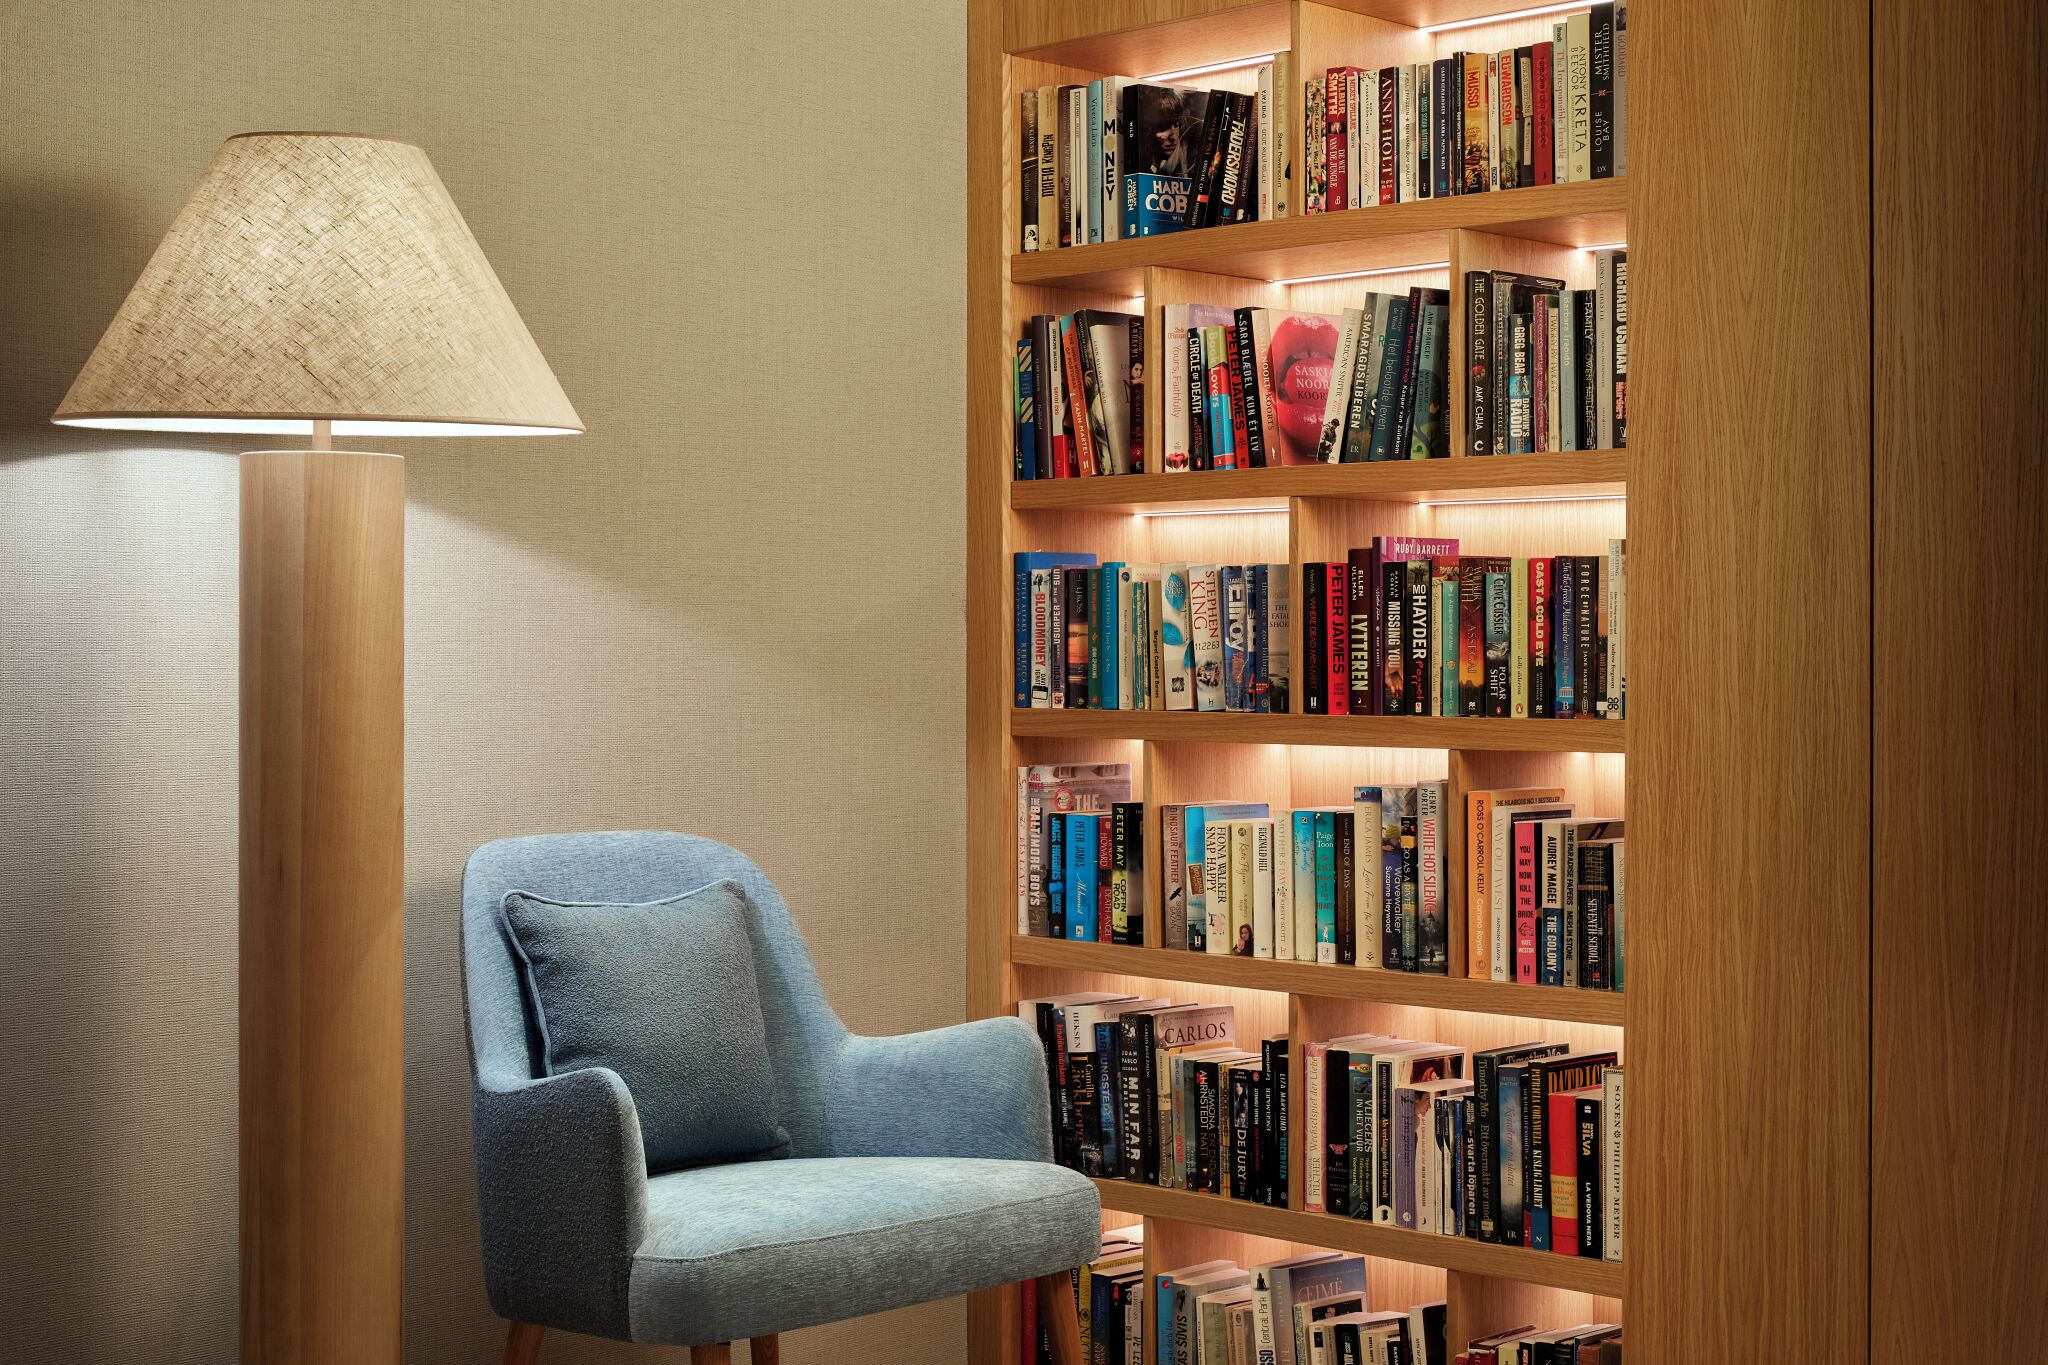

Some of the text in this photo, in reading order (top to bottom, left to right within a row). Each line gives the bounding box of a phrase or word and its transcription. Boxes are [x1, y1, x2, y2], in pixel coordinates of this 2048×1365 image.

[1328, 72, 1338, 114] SMITH
[1337, 70, 1346, 116] WILBUR
[1382, 76, 1392, 124] ANNE
[1575, 94, 1586, 152] KRETA
[1222, 118, 1246, 205] FADERSMORD
[1338, 150, 1346, 159] DE
[1382, 129, 1392, 175] HOLT
[1191, 202, 1200, 226] ullstein
[1424, 327, 1433, 360] GRANGER
[1475, 278, 1484, 360] THE GOLDEN GATE
[1065, 347, 1076, 389] OF PORTUGAL
[1208, 332, 1220, 408] Book Lovers
[1228, 330, 1245, 430] PETER JAMES
[1336, 328, 1352, 398] AMERICAN SNIPER
[1350, 313, 1372, 429] SMARAGDSLIBEREN
[1074, 402, 1088, 456] YANN MARTEL
[1511, 398, 1522, 438] RADIO
[1206, 570, 1218, 638] STEPHEN
[1536, 562, 1544, 594] CAST
[1536, 596, 1544, 604] A
[1035, 594, 1046, 666] BLOODMONEY
[1190, 580, 1207, 630] KING
[1332, 566, 1344, 674] PETER JAMES
[1412, 596, 1426, 659] HAYDER
[1494, 578, 1506, 635] CLIVE CUSSLER
[1536, 606, 1544, 638] COLD
[1352, 614, 1368, 690] LYTTEREN
[1388, 602, 1400, 668] MISSING YOU
[1536, 640, 1544, 666] EYE
[1490, 668, 1498, 697] SHIFT
[1498, 666, 1506, 700] POLAR
[1074, 821, 1085, 868] PETER JAMES
[1206, 826, 1216, 892] SNAP HAPPY
[1218, 826, 1226, 903] FIONA WALKER
[1422, 819, 1436, 914] WHITE HOT SILENCE
[1476, 822, 1484, 894] O'CARROLL-KELLY
[1547, 836, 1557, 904] AUDREY MAGEE
[1394, 867, 1402, 933] Wavewalker
[1517, 910, 1533, 918] BRIDE
[1476, 930, 1484, 956] Royale
[1547, 916, 1557, 972] THE COLONY
[1566, 911, 1574, 960] MERLIN STONE
[1072, 1012, 1081, 1049] HEKSEN
[1164, 1022, 1226, 1044] CARLOS
[1085, 1064, 1094, 1098] Camilla
[1356, 1098, 1363, 1109] IN
[1478, 1059, 1489, 1117] Timothy Mo
[1129, 1076, 1140, 1161] MIN FAR
[1364, 1099, 1372, 1152] VLIEGERS
[1532, 1068, 1544, 1208] PATRICIA CORNWELL KUSLIG LIKHET
[1582, 1122, 1591, 1156] SILVA
[1237, 1129, 1247, 1180] DE JURY
[1312, 1158, 1320, 1196] PILCHER
[1467, 1137, 1476, 1215] svarta löparen
